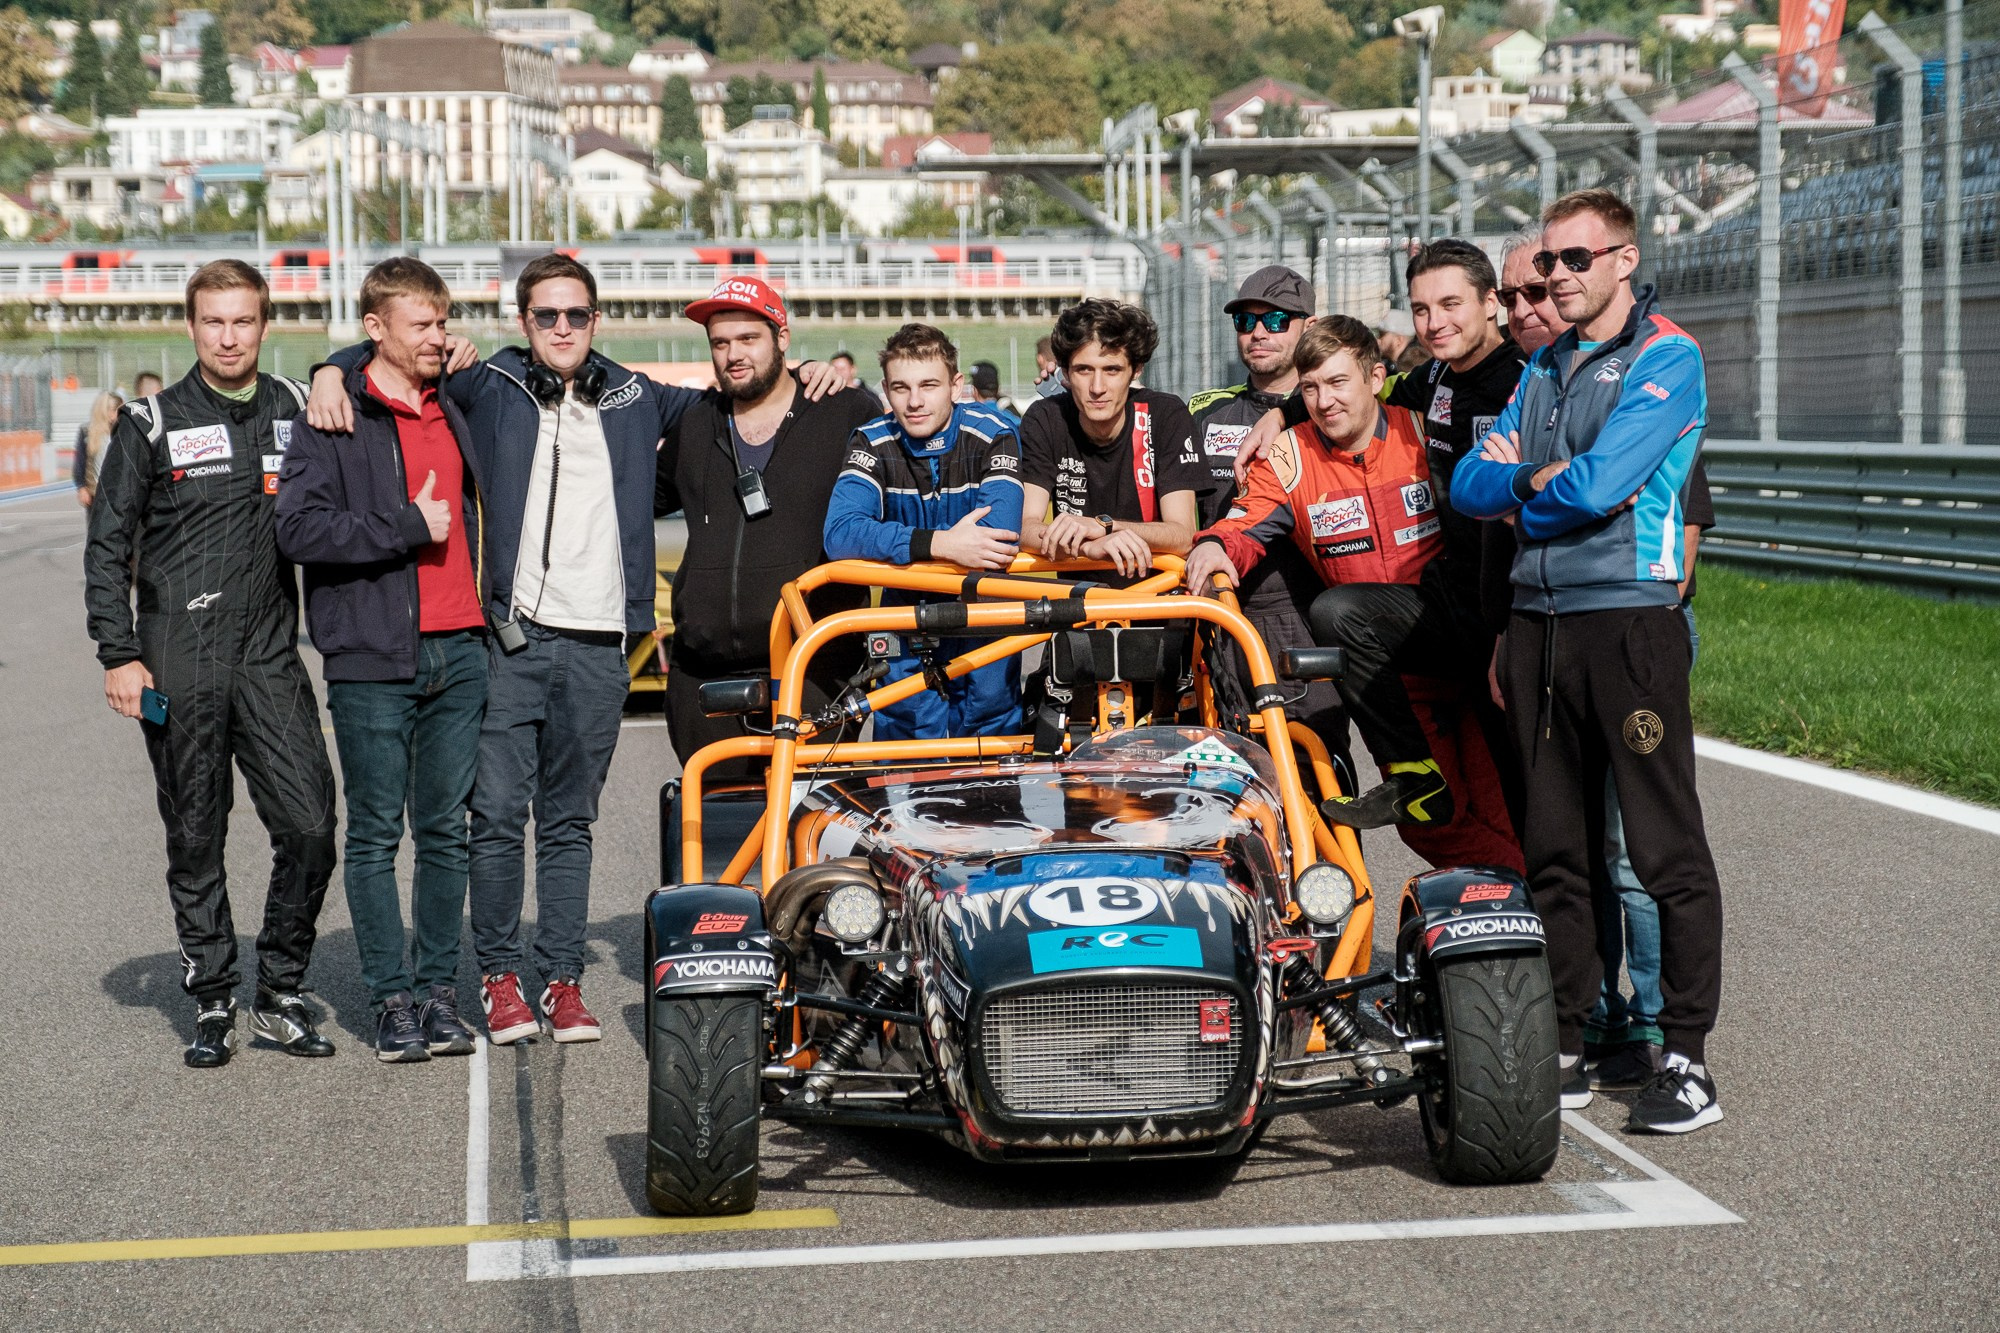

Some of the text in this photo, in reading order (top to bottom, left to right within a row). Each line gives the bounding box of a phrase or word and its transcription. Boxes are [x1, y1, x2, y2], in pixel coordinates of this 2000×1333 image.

[730, 293, 751, 304] TEAM
[925, 439, 944, 450] OMP
[850, 451, 877, 469] OMP
[991, 456, 1018, 468] OMP
[185, 464, 231, 478] YOKOHAMA
[1327, 541, 1369, 554] YOKOHAMA
[1637, 725, 1647, 739] V
[1045, 884, 1143, 915] 18
[1465, 891, 1506, 900] CUP
[698, 922, 740, 931] CUP
[1445, 918, 1545, 939] YOKOHAMA
[673, 958, 776, 979] YOKOHAMA
